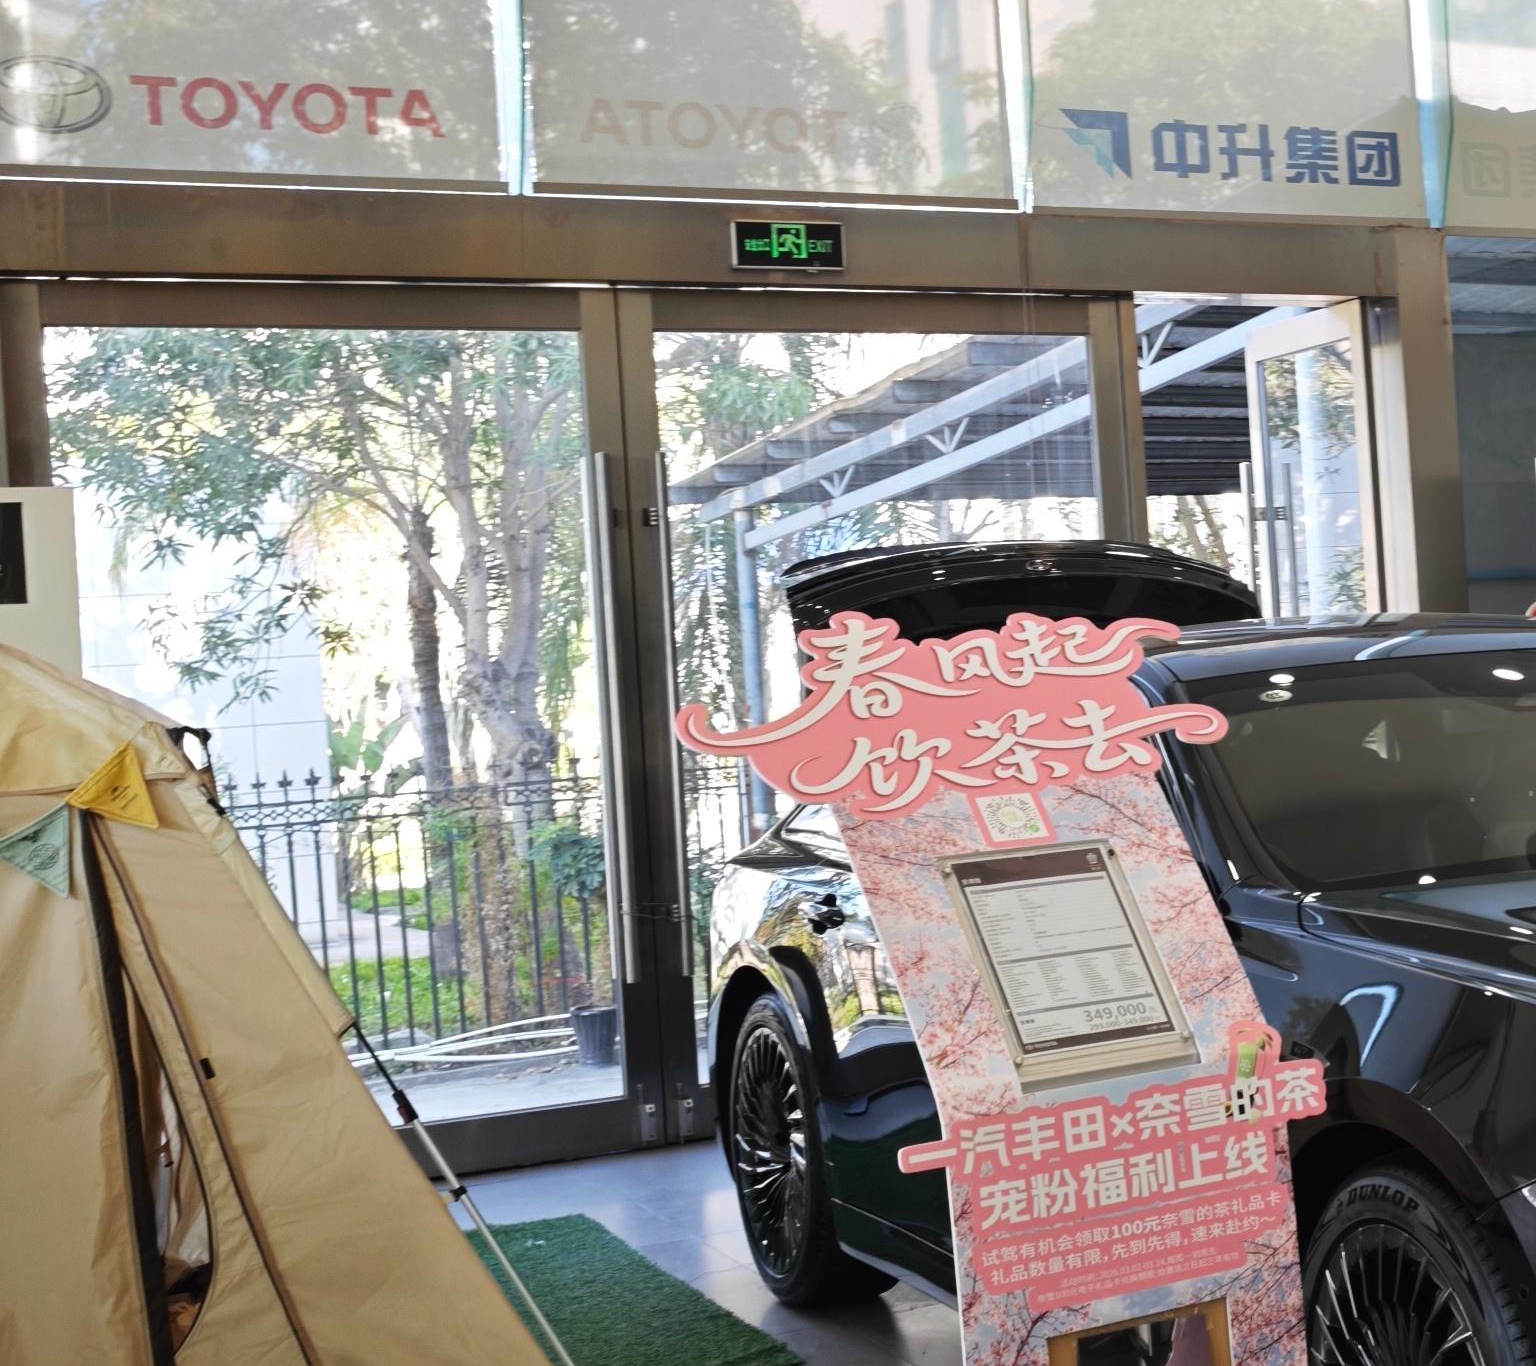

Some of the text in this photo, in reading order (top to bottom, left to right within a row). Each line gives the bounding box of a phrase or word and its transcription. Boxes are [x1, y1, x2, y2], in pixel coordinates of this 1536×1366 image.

[130, 74, 446, 138] TOYOTA
[1152, 118, 1401, 187] 中升集团
[687, 619, 1164, 746] 春风起
[790, 699, 1218, 812] 饮茶去
[1083, 1002, 1147, 1023] 349,000
[979, 1129, 1268, 1230] 宠粉福利上线
[1347, 1184, 1420, 1213] DUNLOP
[981, 1191, 1281, 1267] 试驾有机会领取100元奈雪的茶礼品卡
